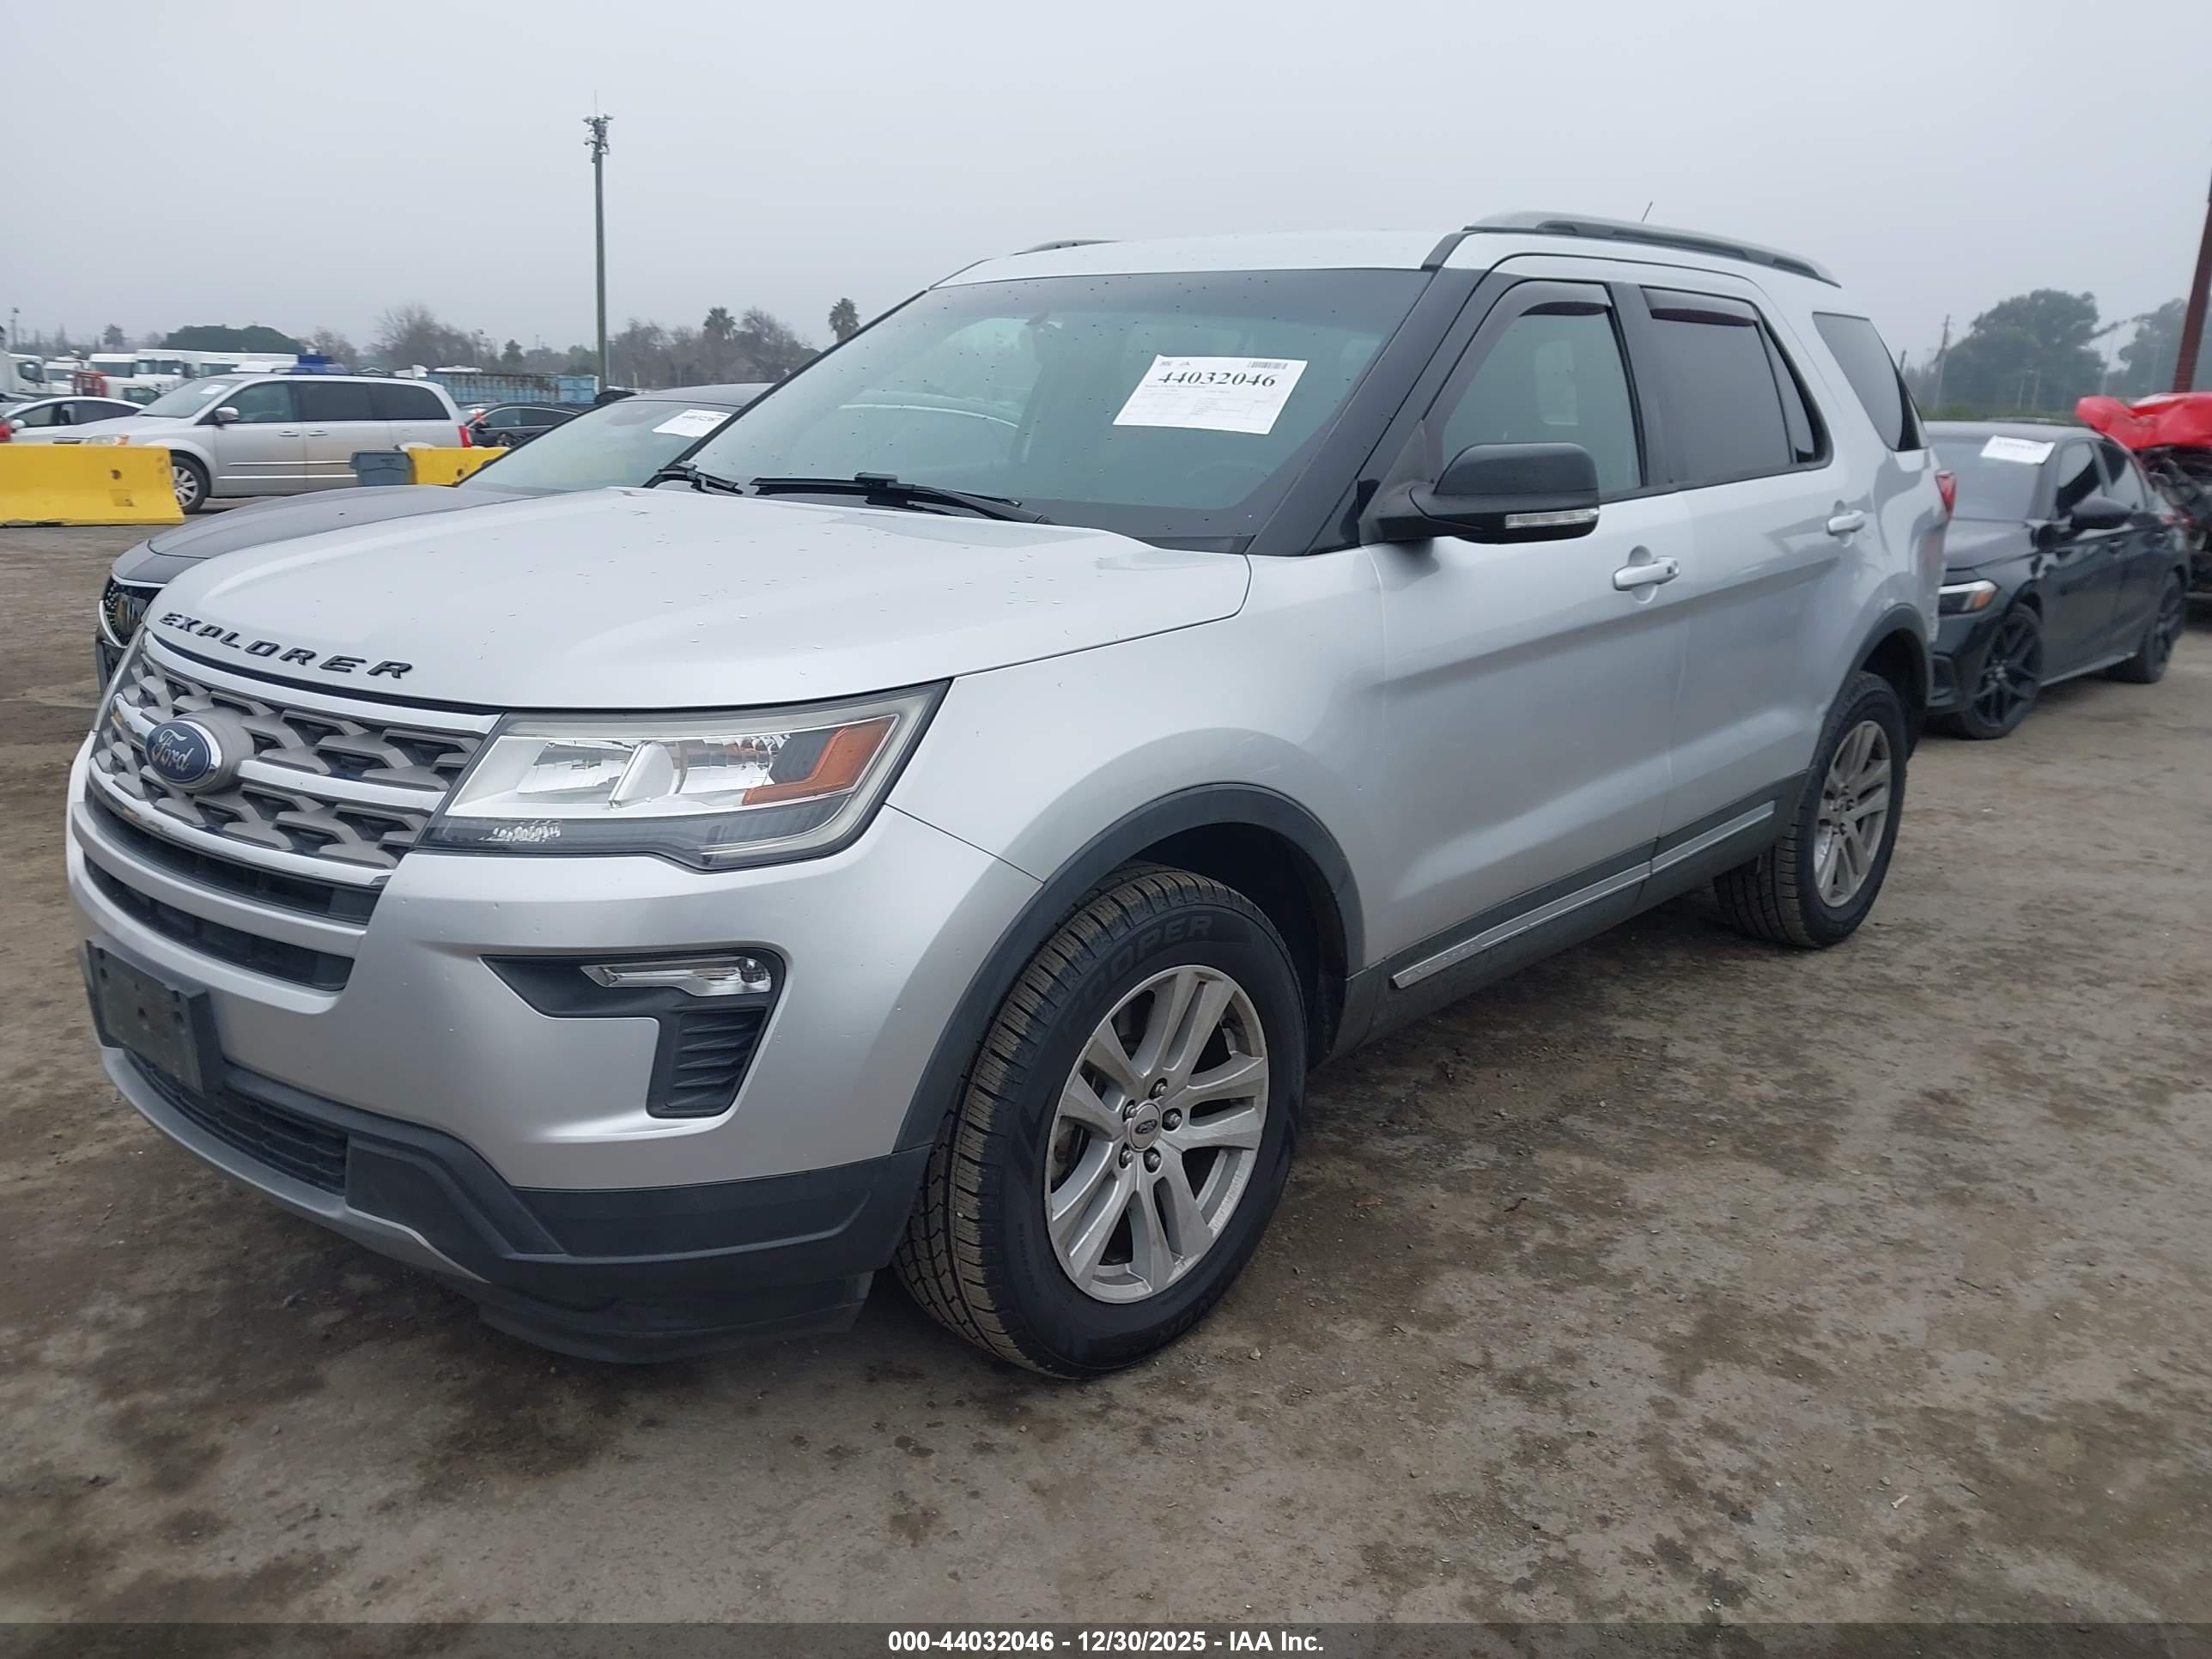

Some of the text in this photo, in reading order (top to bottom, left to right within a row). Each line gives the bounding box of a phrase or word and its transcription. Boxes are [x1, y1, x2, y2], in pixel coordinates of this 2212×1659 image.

[1158, 371, 1278, 387] 44032046
[158, 611, 413, 679] EXPLORER
[151, 728, 195, 772] Ford
